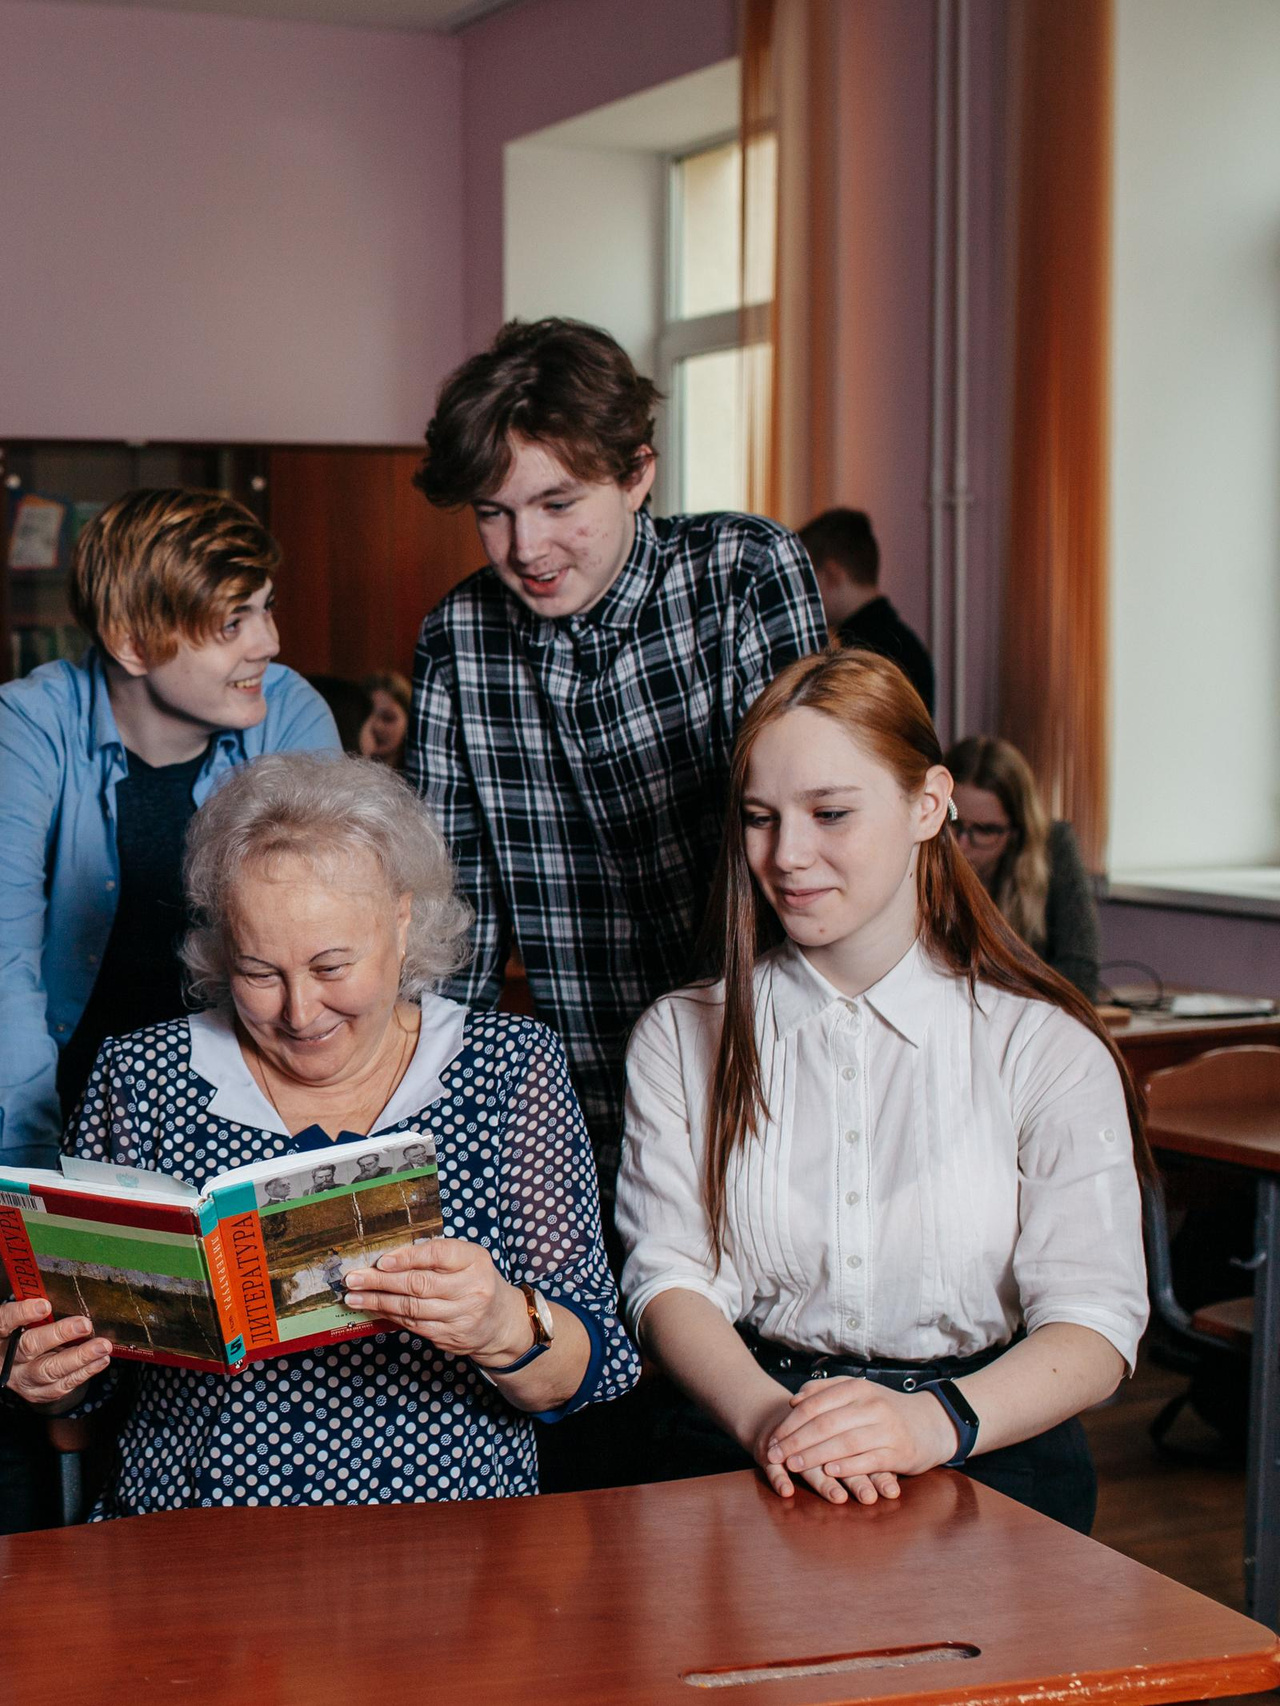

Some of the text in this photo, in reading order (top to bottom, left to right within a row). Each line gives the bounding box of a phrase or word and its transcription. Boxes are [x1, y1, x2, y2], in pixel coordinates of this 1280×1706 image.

[210, 1236, 233, 1311] ЛИТЕРАТУРА
[231, 1214, 274, 1344] ЛИТЕРАТУРА
[230, 1338, 243, 1356] 5
